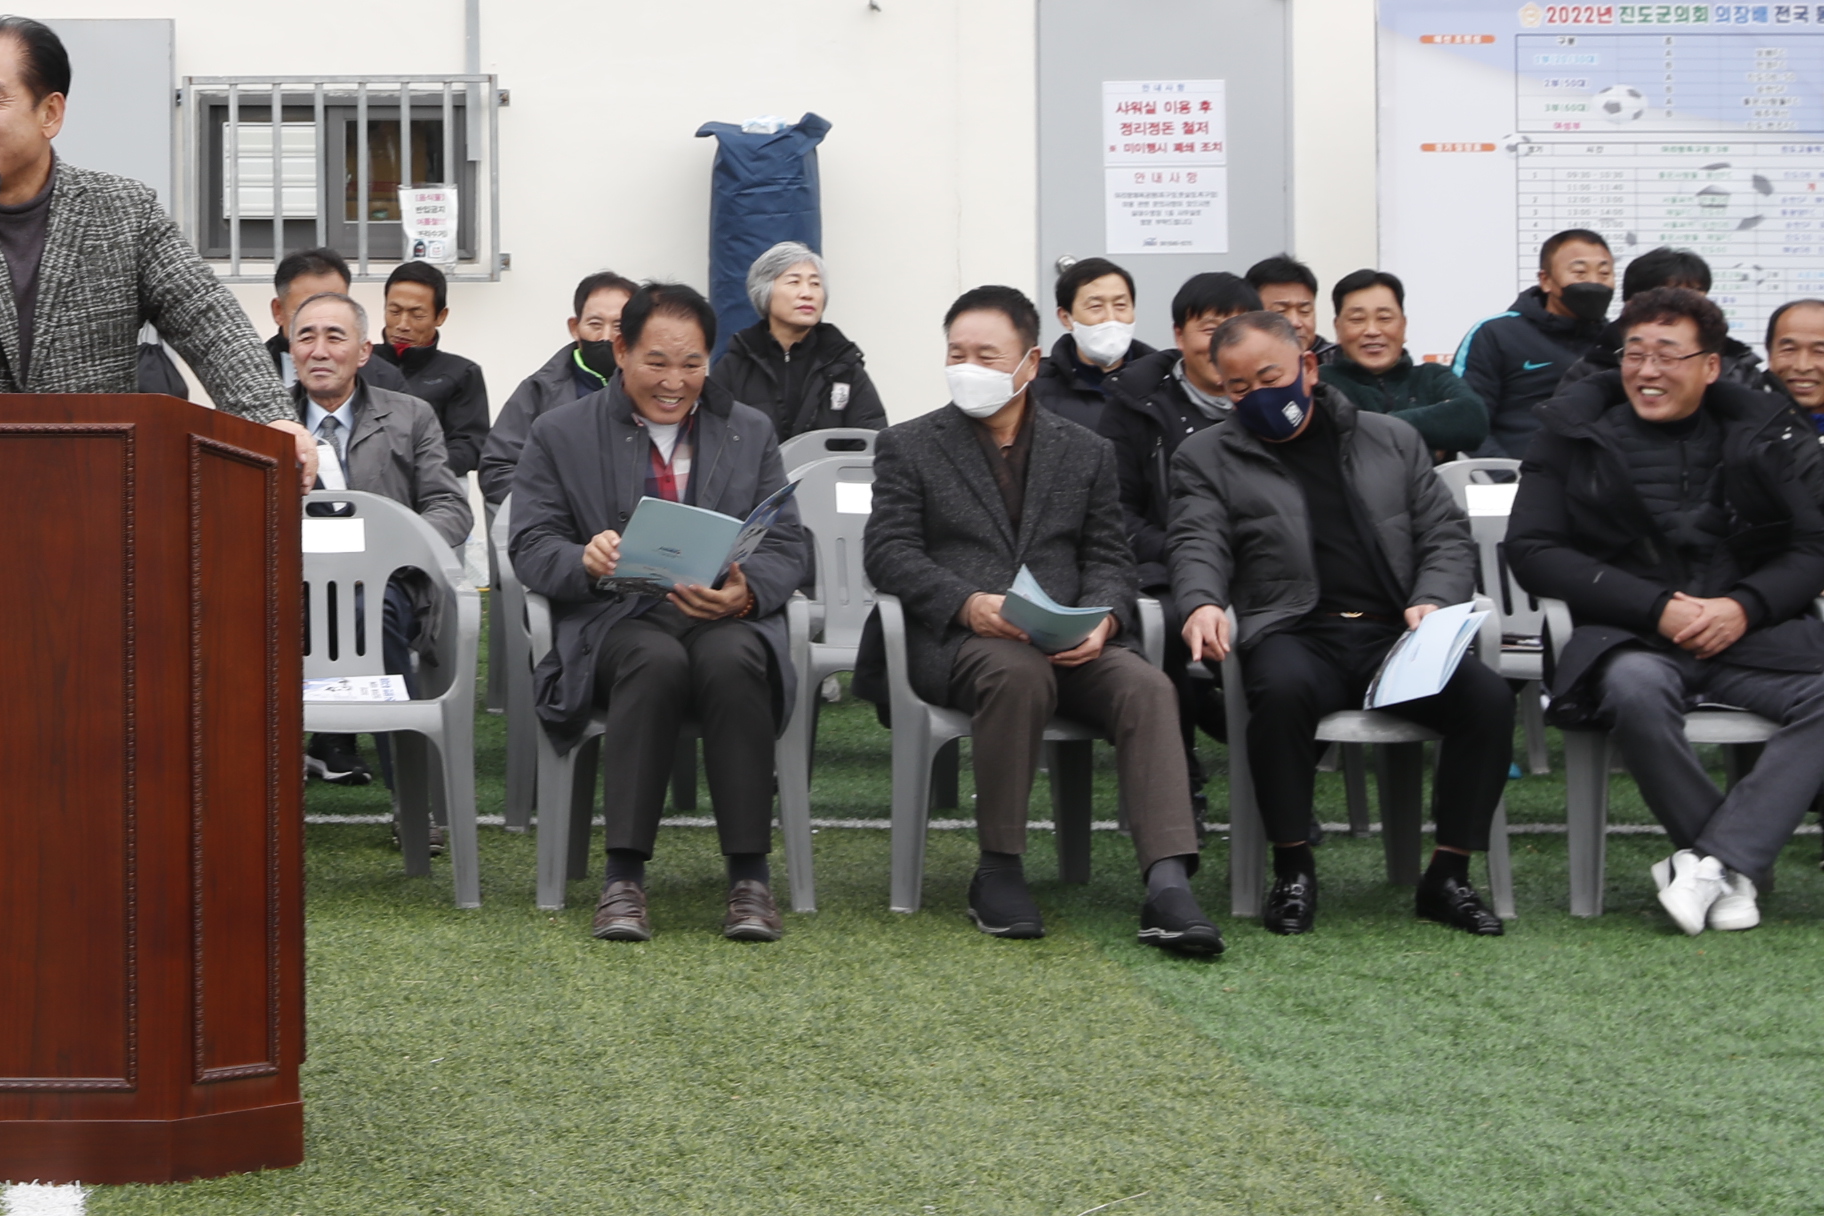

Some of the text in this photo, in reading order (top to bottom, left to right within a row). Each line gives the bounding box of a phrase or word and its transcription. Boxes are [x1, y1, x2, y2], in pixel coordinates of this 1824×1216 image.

[1546, 5, 1614, 25] 2022년
[1618, 5, 1710, 24] 진도군의회
[1714, 5, 1769, 24] 의장배
[1775, 5, 1810, 24] 전국
[1115, 99, 1213, 115] 샤워실 이용 후
[1119, 120, 1210, 136] 정리정돈 철저
[1123, 142, 1168, 154] 미이행시
[1199, 141, 1223, 153] 조치
